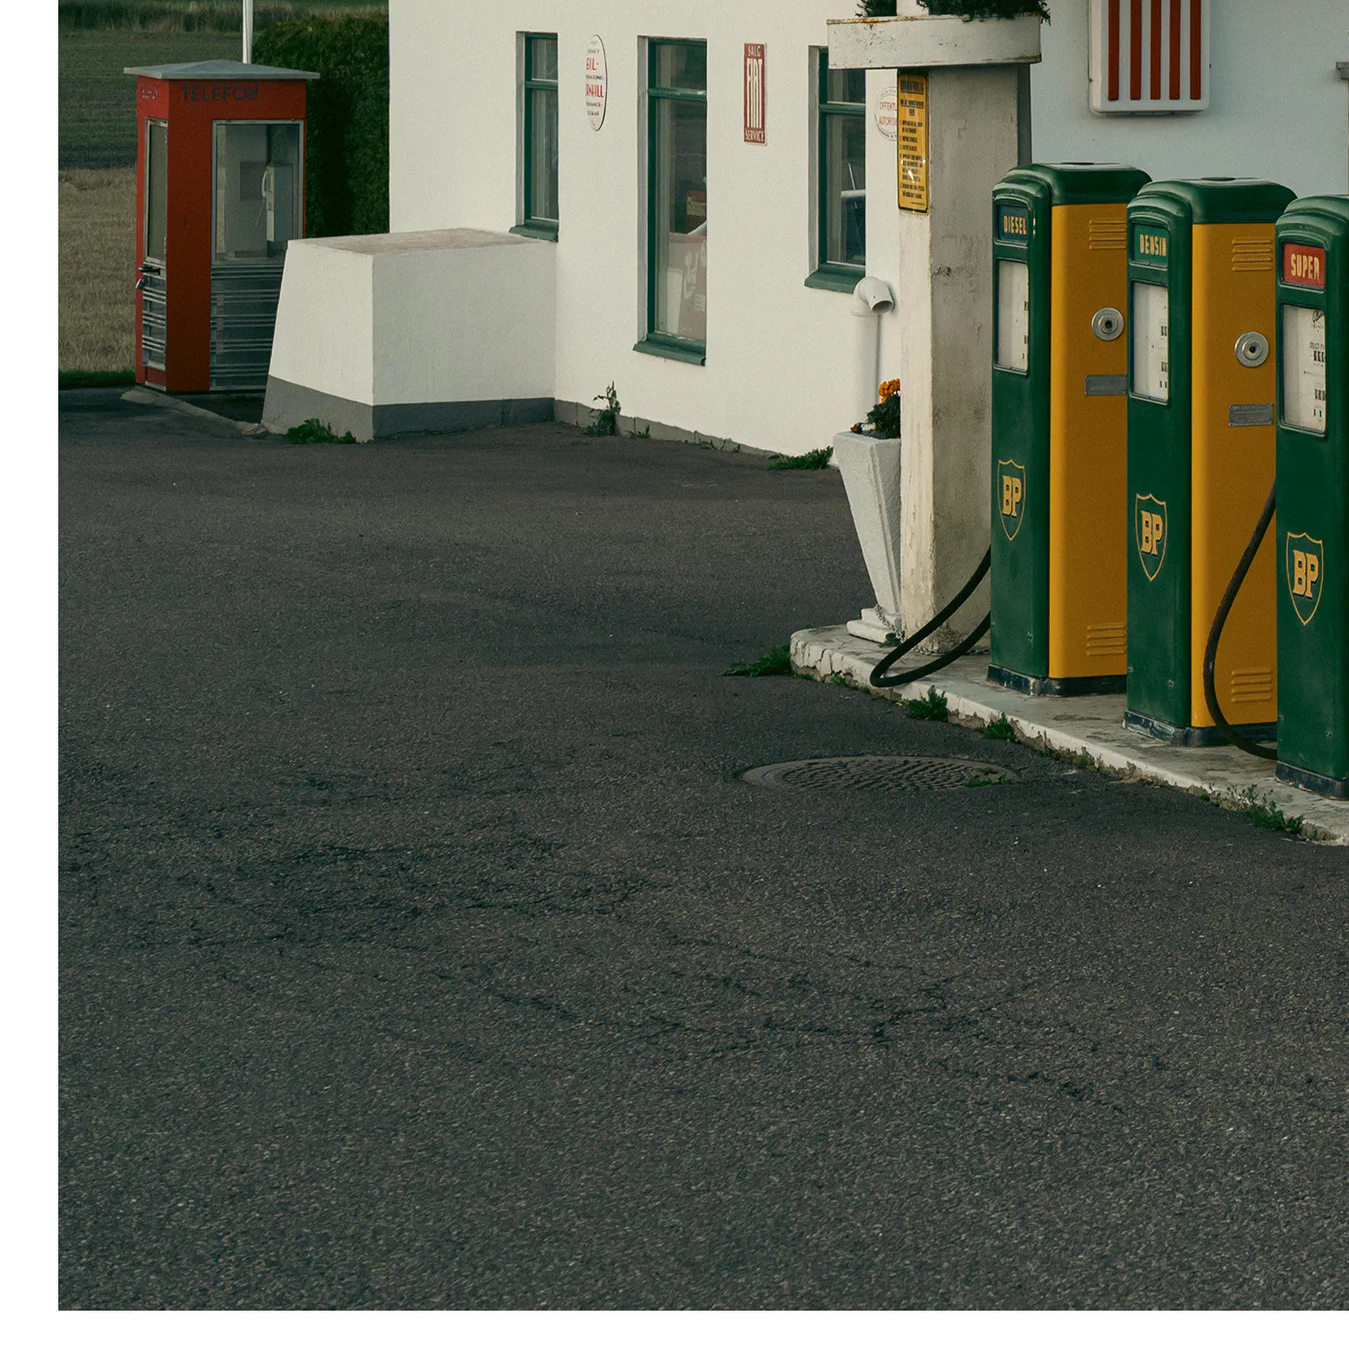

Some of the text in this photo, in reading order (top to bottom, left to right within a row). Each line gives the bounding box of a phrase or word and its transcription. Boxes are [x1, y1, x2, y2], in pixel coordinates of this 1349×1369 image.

[747, 45, 762, 57] SALG
[181, 86, 259, 102] TELEFON
[746, 58, 763, 129] FIAT
[879, 101, 897, 111] OFFENTL
[878, 116, 897, 126] AUTORIS
[745, 130, 764, 142] SERVICE
[1003, 215, 1027, 235] DIESEL
[1290, 253, 1320, 281] SUPER
[1002, 475, 1023, 519] BP
[1141, 509, 1164, 556] BP
[1293, 550, 1320, 600] BP
